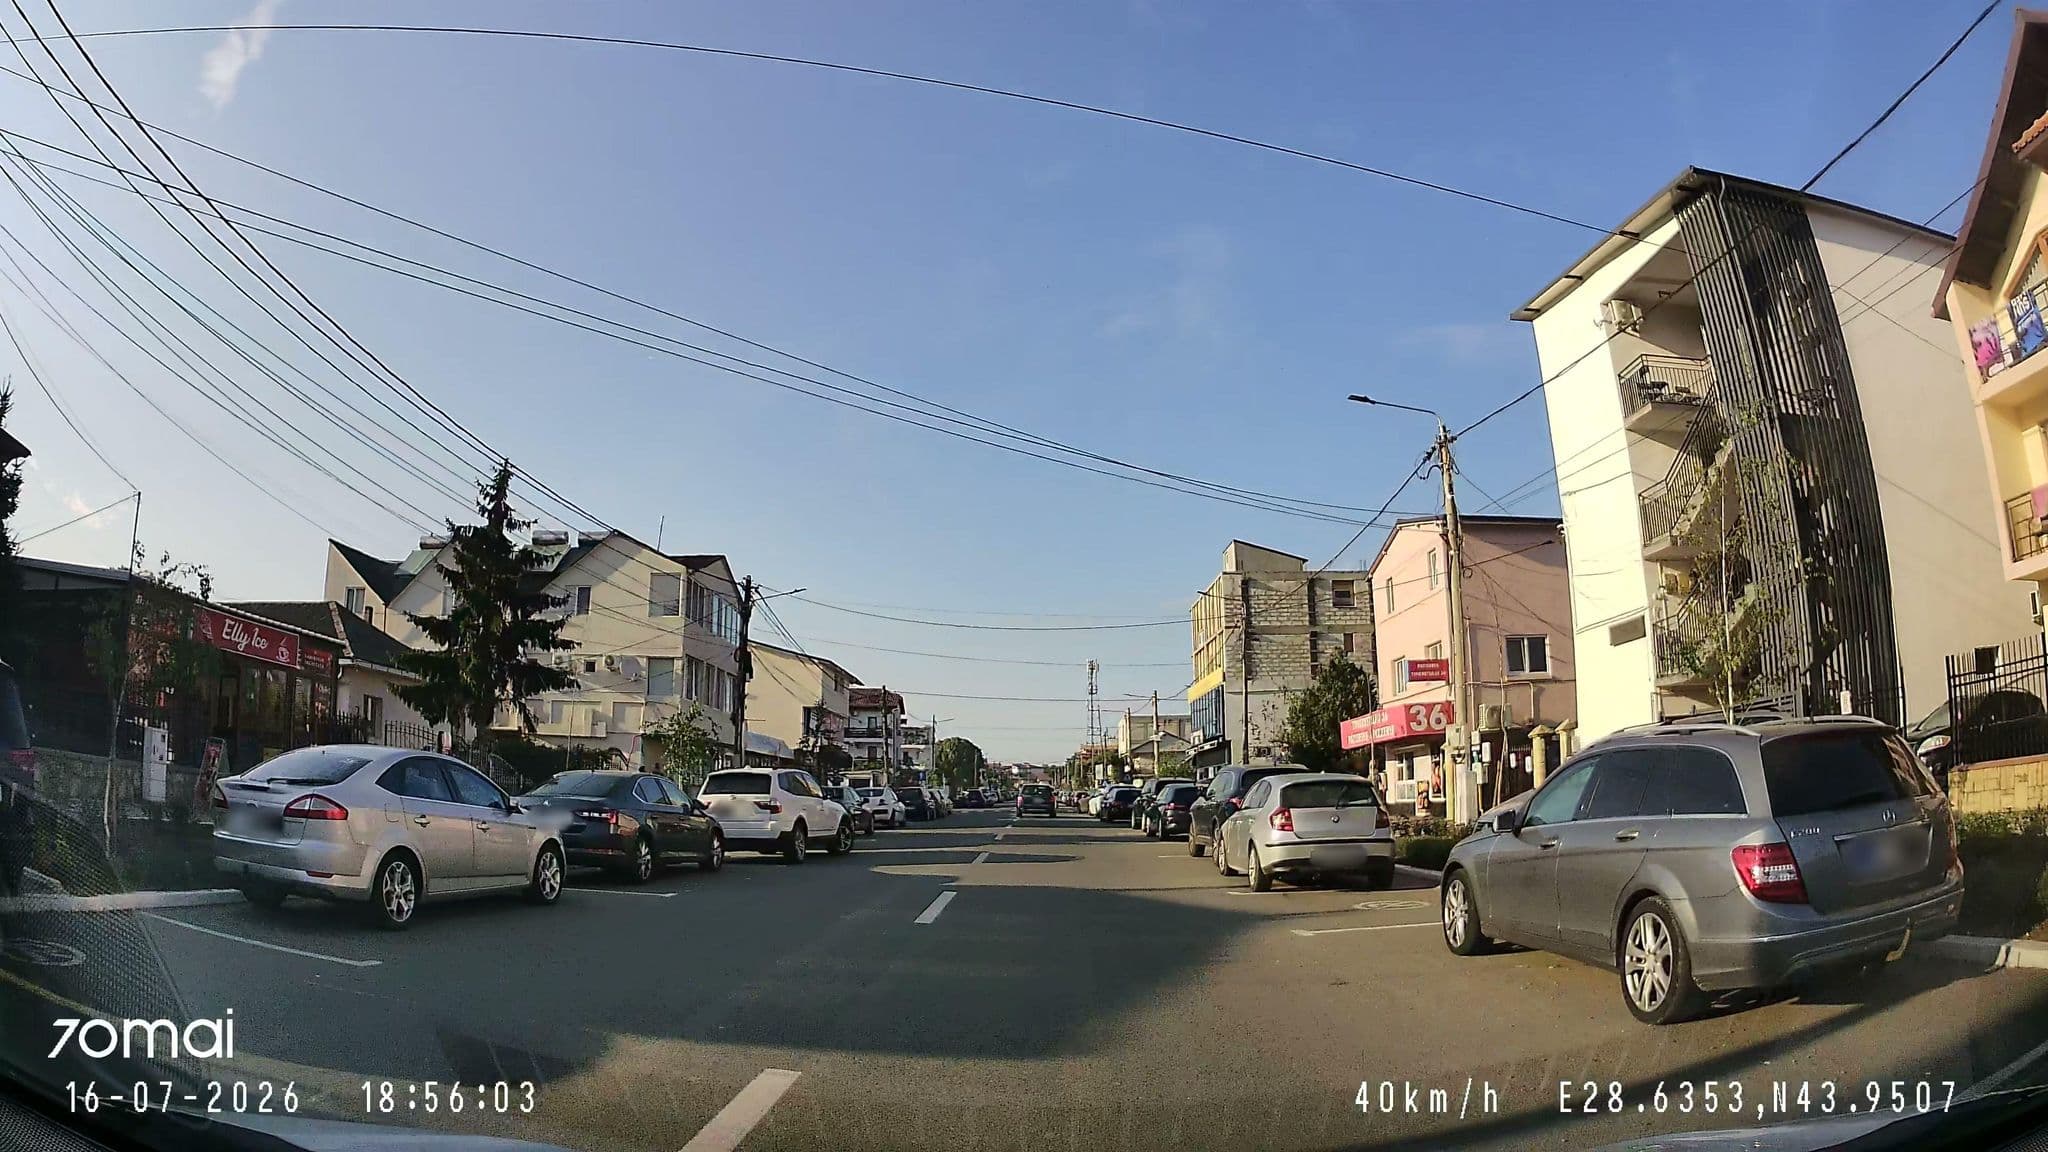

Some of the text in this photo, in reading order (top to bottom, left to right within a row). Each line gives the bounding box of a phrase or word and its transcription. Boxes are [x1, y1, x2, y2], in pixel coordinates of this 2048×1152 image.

[222, 618, 269, 651] Elly Ice
[1409, 704, 1448, 732] 36
